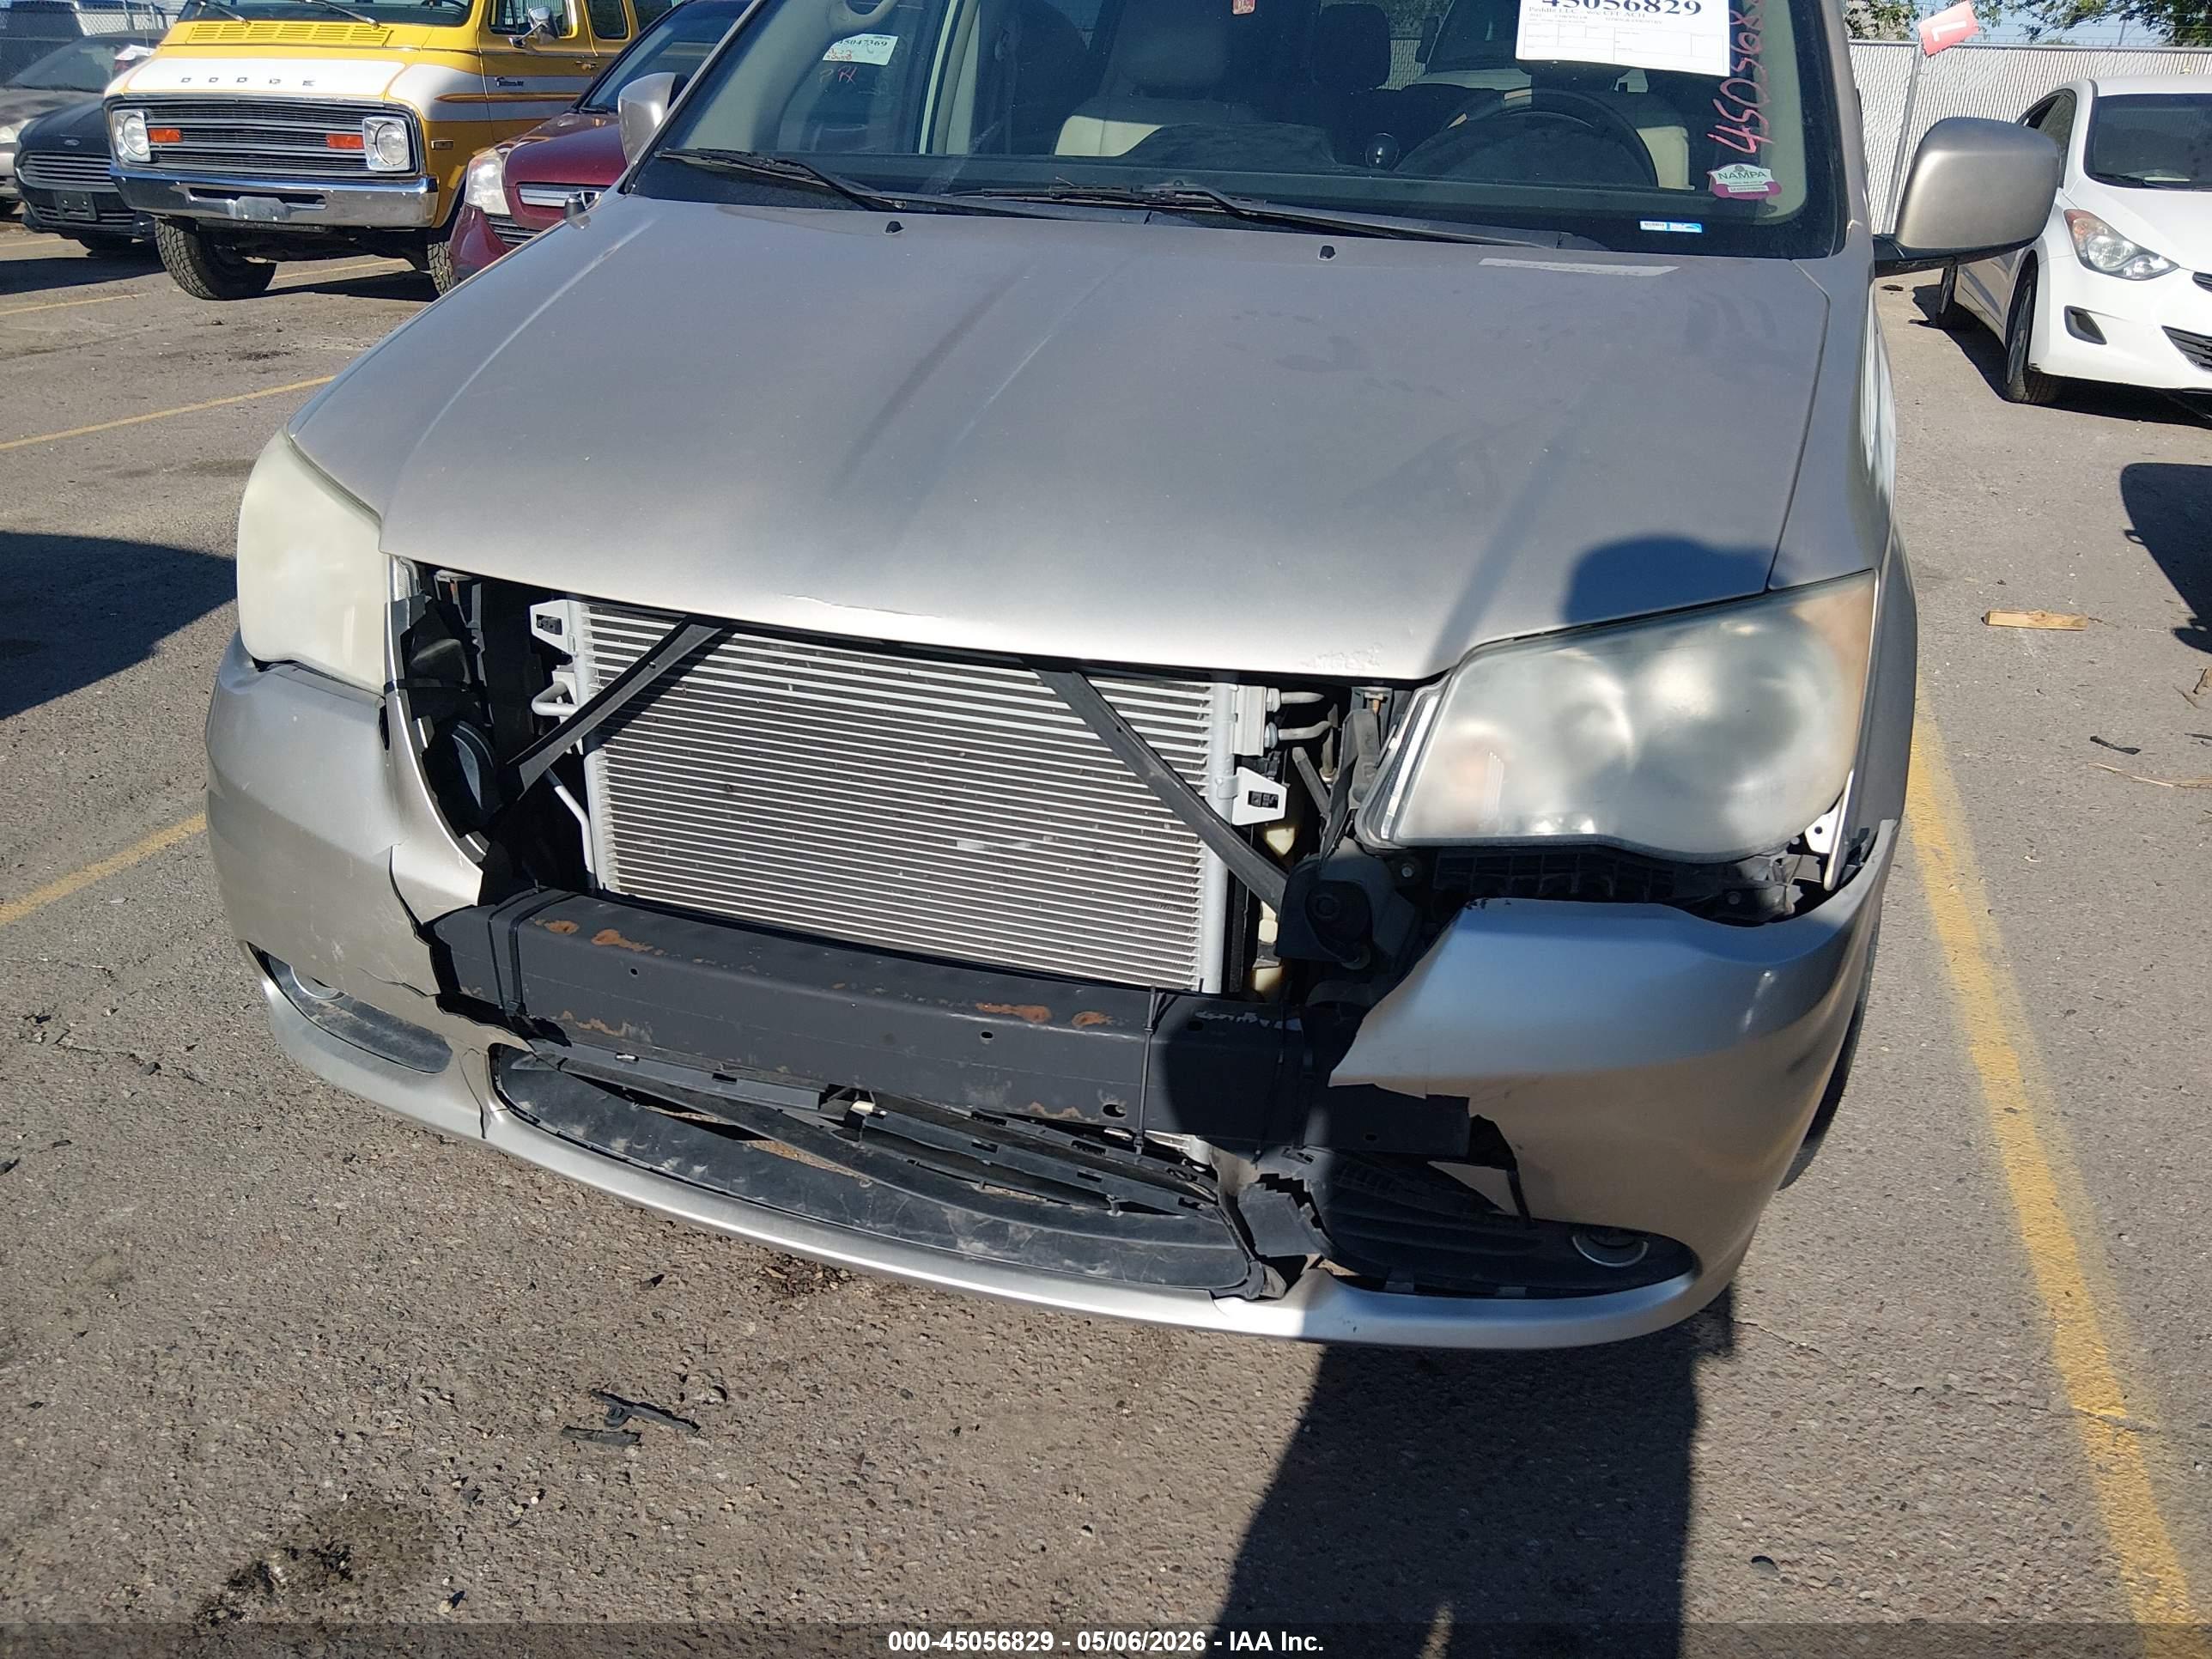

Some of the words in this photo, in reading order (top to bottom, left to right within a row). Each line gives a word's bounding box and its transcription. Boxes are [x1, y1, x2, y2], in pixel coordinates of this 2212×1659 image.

[180, 76, 316, 87] DODGE
[1706, 0, 1775, 153] 450568
[1718, 171, 1766, 179] NAMPA
